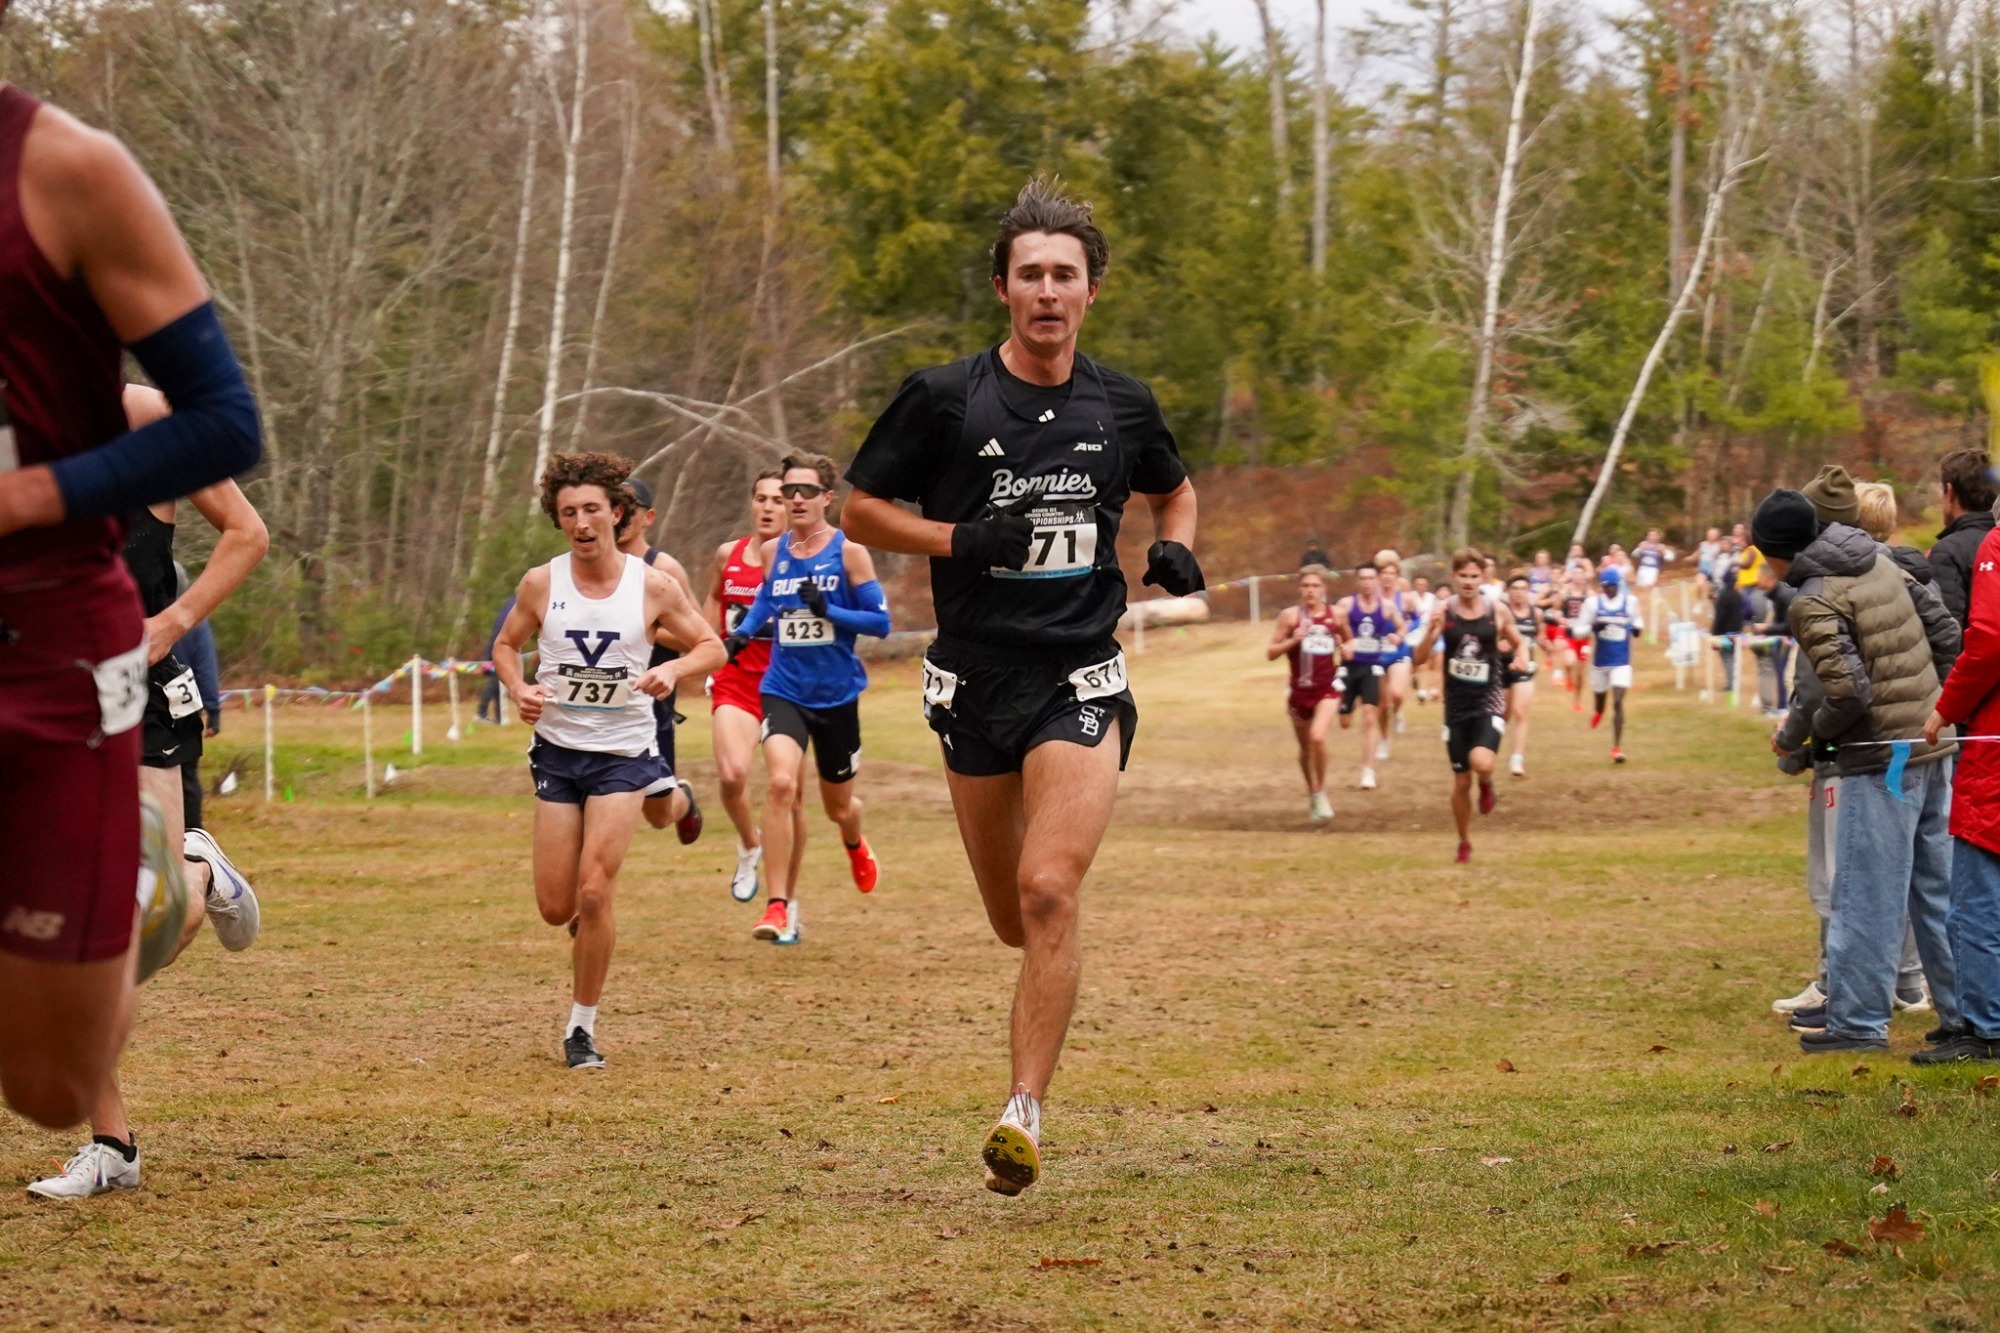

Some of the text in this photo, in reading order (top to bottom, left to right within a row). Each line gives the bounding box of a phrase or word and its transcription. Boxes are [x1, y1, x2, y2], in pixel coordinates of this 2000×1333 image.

[989, 467, 1097, 500] Bonnies
[1030, 515, 1074, 526] MPIONSHIPS
[1034, 530, 1076, 566] 71
[772, 574, 840, 597] BUFLO
[785, 620, 824, 640] 423
[565, 630, 620, 667] V
[1083, 658, 1121, 688] 671
[1455, 663, 1482, 678] 607
[567, 680, 618, 705] 737
